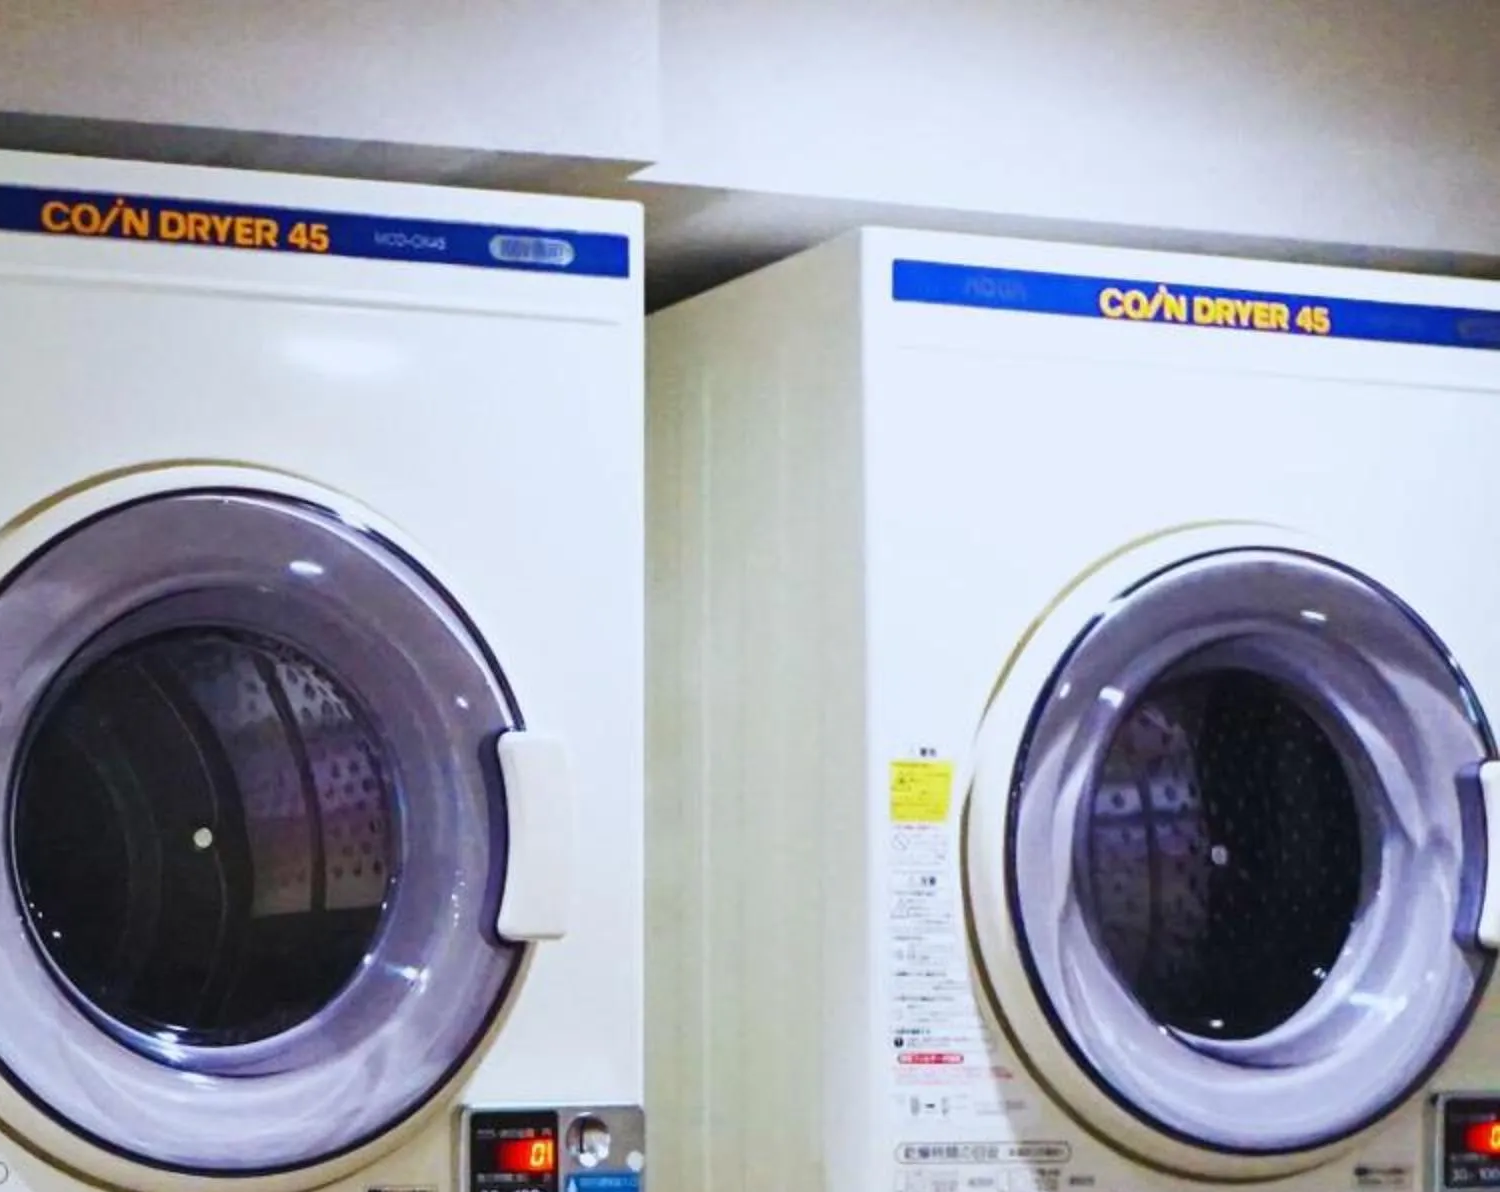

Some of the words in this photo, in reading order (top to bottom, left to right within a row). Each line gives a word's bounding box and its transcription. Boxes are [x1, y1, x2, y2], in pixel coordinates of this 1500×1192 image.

[41, 197, 150, 237] COIN
[159, 209, 279, 248] DRYER
[287, 222, 331, 252] 45
[1099, 283, 1188, 323] COIN
[1192, 296, 1291, 333] DRYER
[1295, 305, 1331, 335] 45
[530, 1143, 545, 1168] 0
